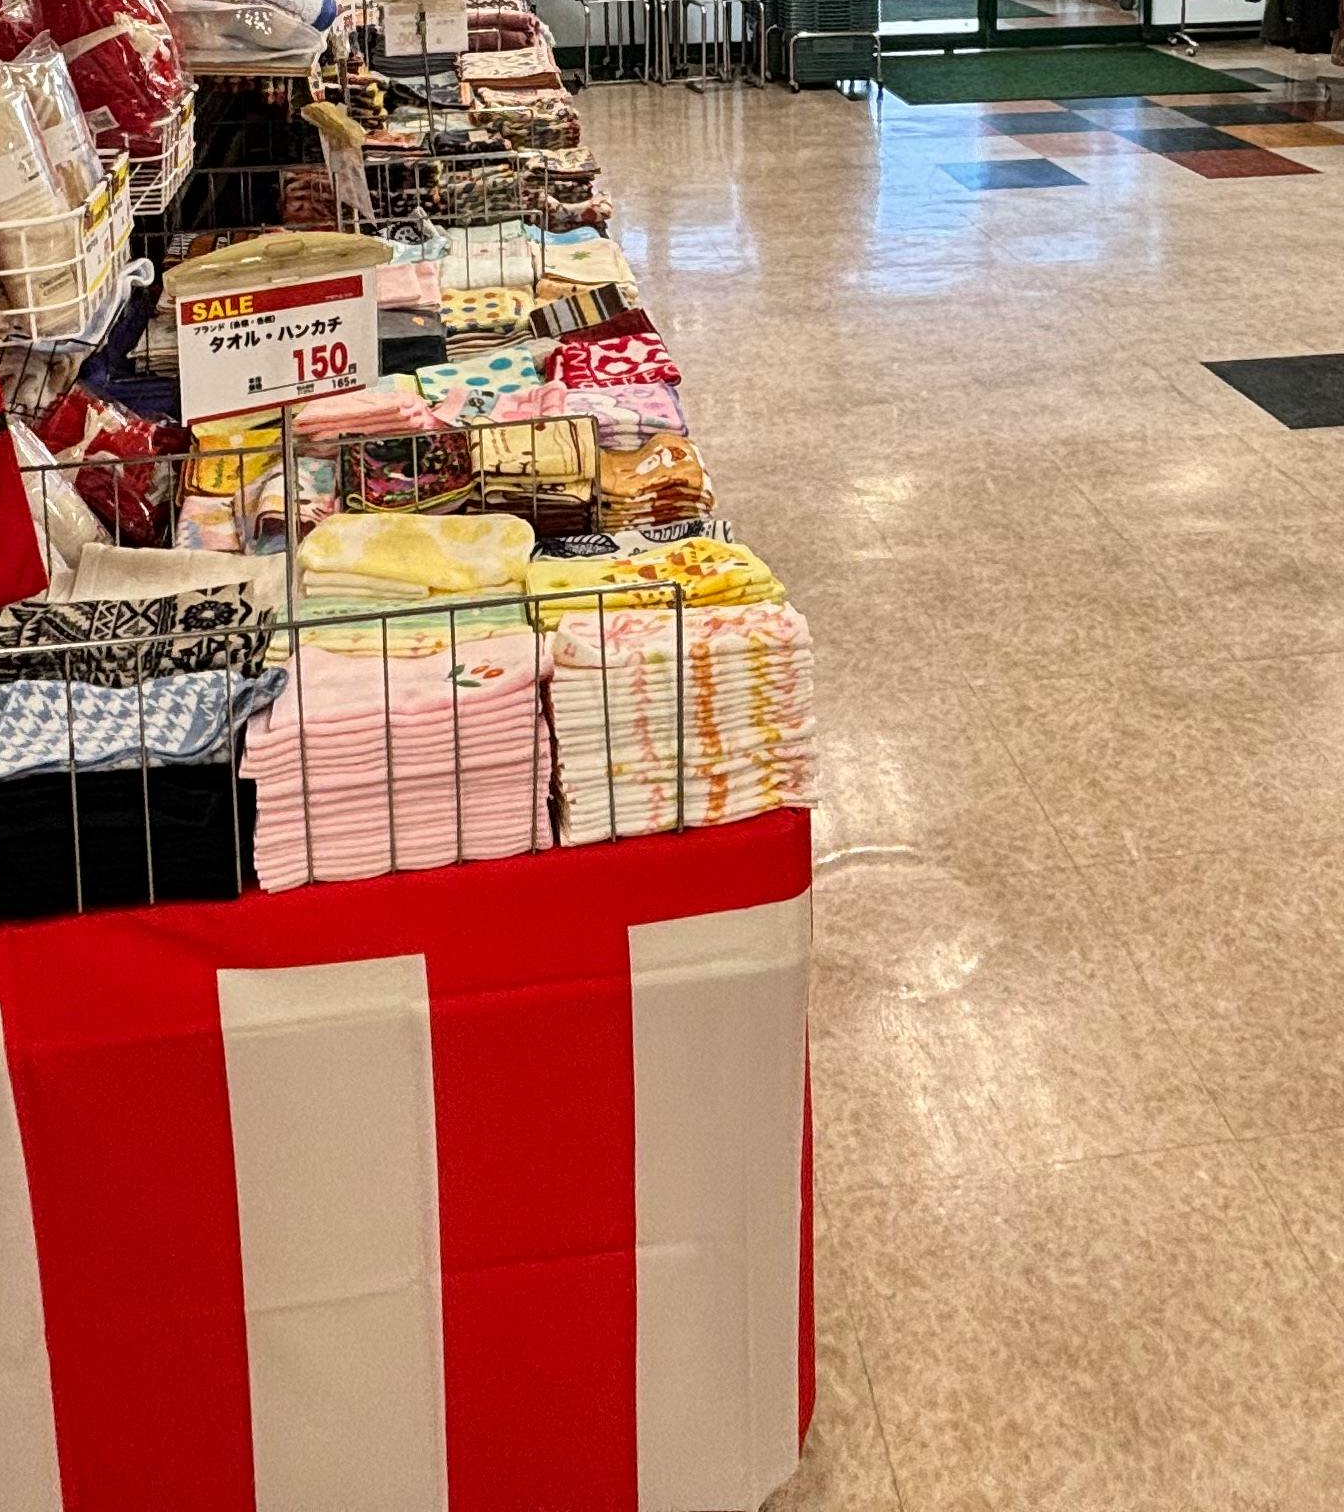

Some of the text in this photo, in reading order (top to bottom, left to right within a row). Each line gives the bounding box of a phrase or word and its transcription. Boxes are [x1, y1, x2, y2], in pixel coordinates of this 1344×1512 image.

[192, 295, 254, 322] SALE
[208, 315, 344, 354] タオル・ハンカチ
